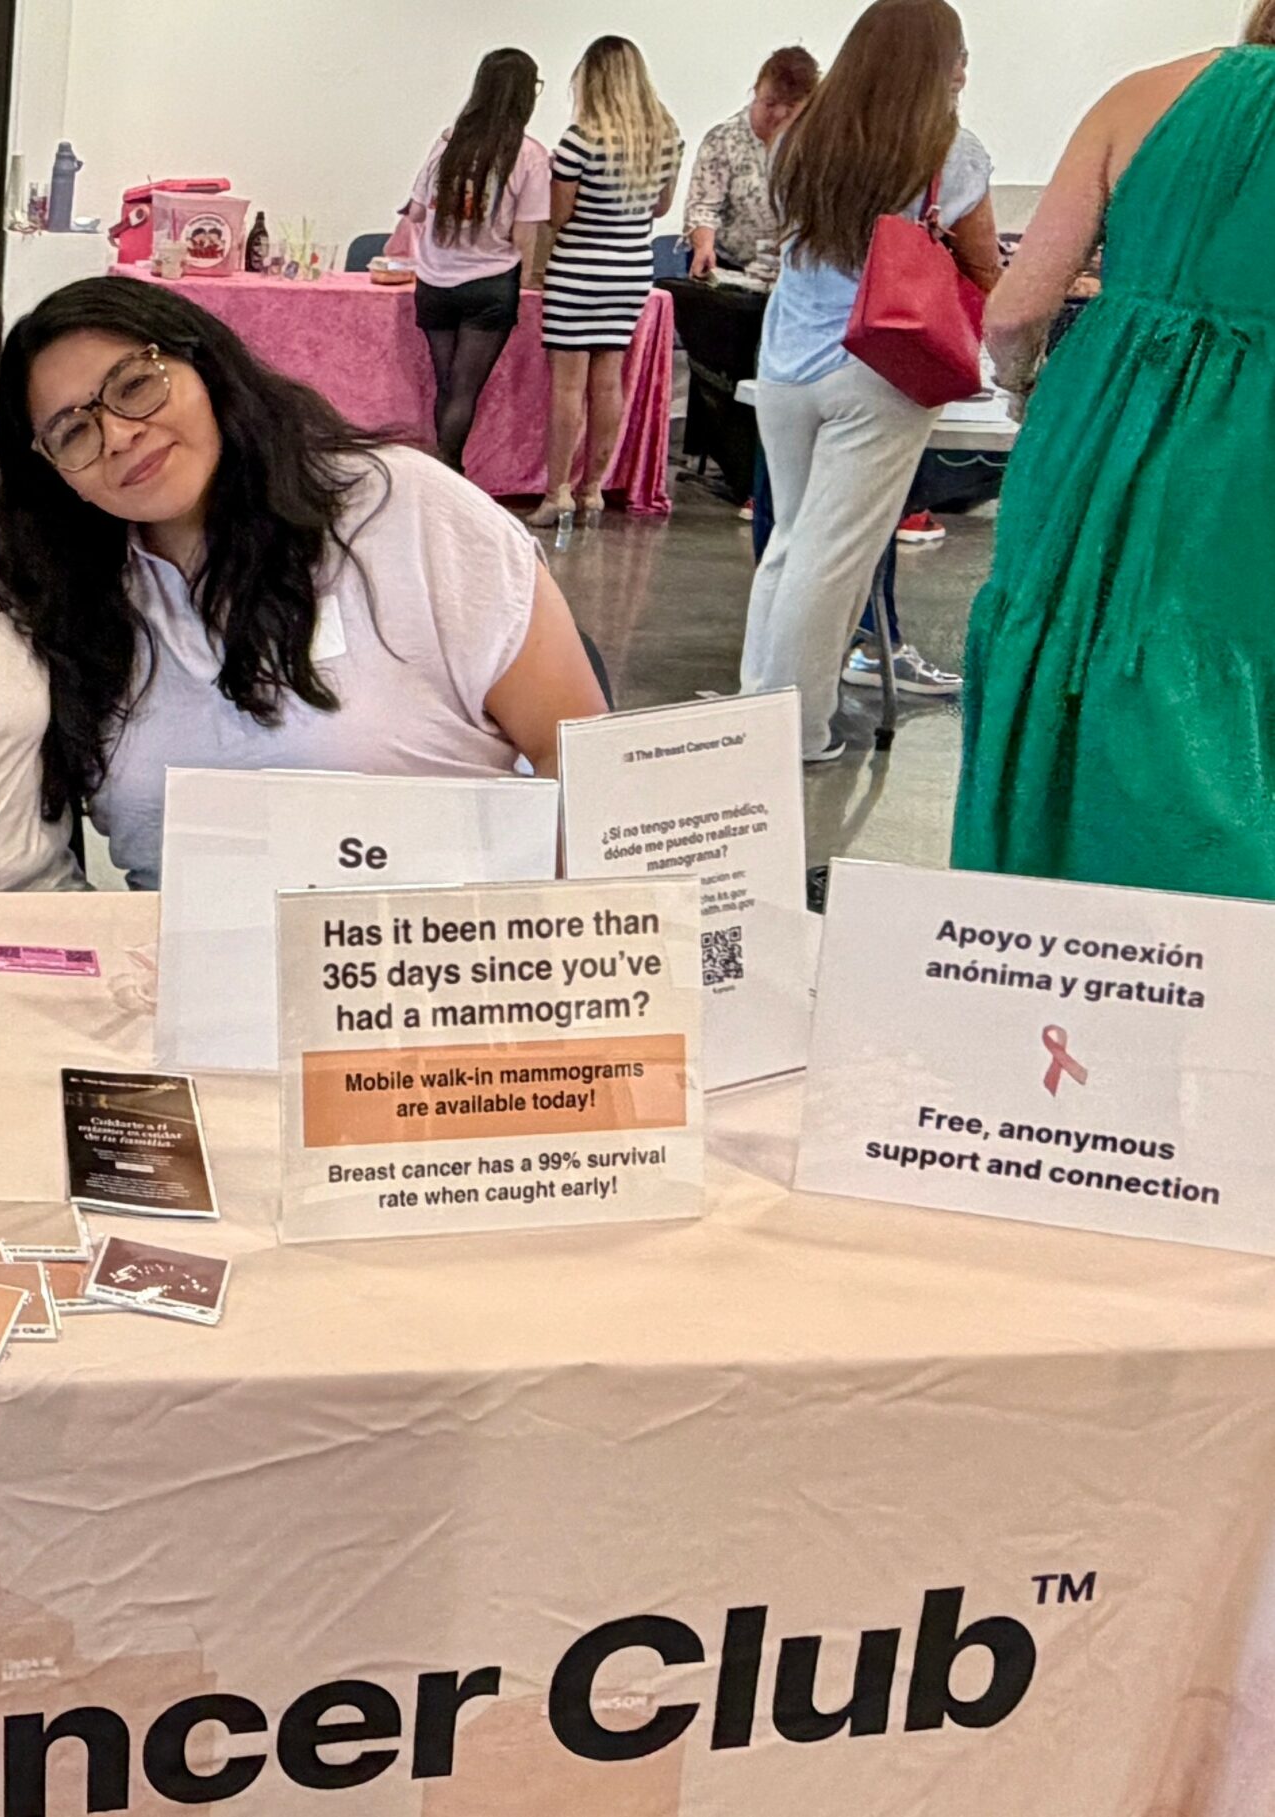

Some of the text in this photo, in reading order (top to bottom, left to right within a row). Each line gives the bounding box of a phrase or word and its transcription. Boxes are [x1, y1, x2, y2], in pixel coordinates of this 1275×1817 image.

[623, 825, 638, 838] no
[640, 819, 676, 835] tengo
[678, 812, 719, 829] seguro
[645, 840, 664, 853] me
[666, 832, 704, 852] puedo
[706, 824, 749, 842] realizar
[752, 821, 768, 833] un
[339, 838, 387, 869] Se
[647, 844, 728, 872] mamograma?
[325, 910, 658, 947] Has it been more than
[936, 920, 1203, 969] Apoyo y conexión
[324, 962, 376, 989] 365
[388, 960, 460, 992] days
[472, 956, 552, 983] since
[926, 960, 1204, 1007] anónima y gratuita
[337, 991, 649, 1031] had a mammogram?
[346, 1063, 643, 1091] Mobile walk-in mammograms
[397, 1089, 594, 1117] are available today!
[919, 1107, 1174, 1159] Free, anonymous
[329, 1146, 665, 1183] Breast cancer has a 99% survival
[866, 1142, 1219, 1204] support and connection
[379, 1176, 617, 1208] rate when caught early!
